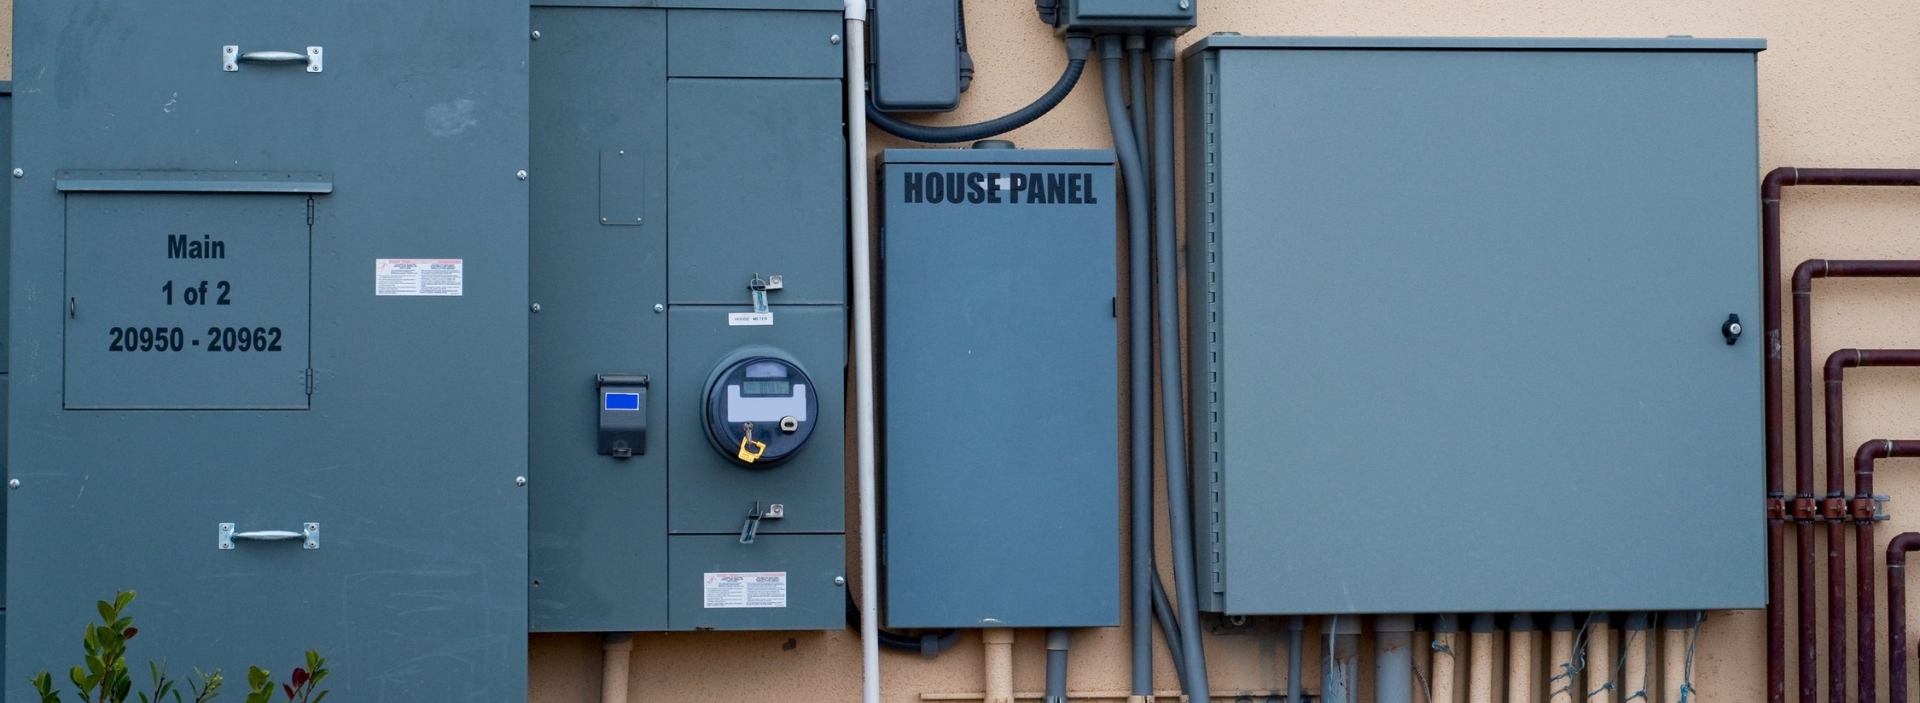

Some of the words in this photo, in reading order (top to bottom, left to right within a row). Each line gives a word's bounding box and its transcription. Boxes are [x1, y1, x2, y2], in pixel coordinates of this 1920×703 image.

[904, 172, 1002, 204] HOUSE
[1009, 172, 1097, 204] PANEL
[167, 234, 226, 259] Main
[162, 280, 173, 305] 1
[183, 280, 208, 305] of
[216, 280, 231, 305] 2
[108, 327, 184, 352] 20950
[207, 327, 282, 352] 20962
